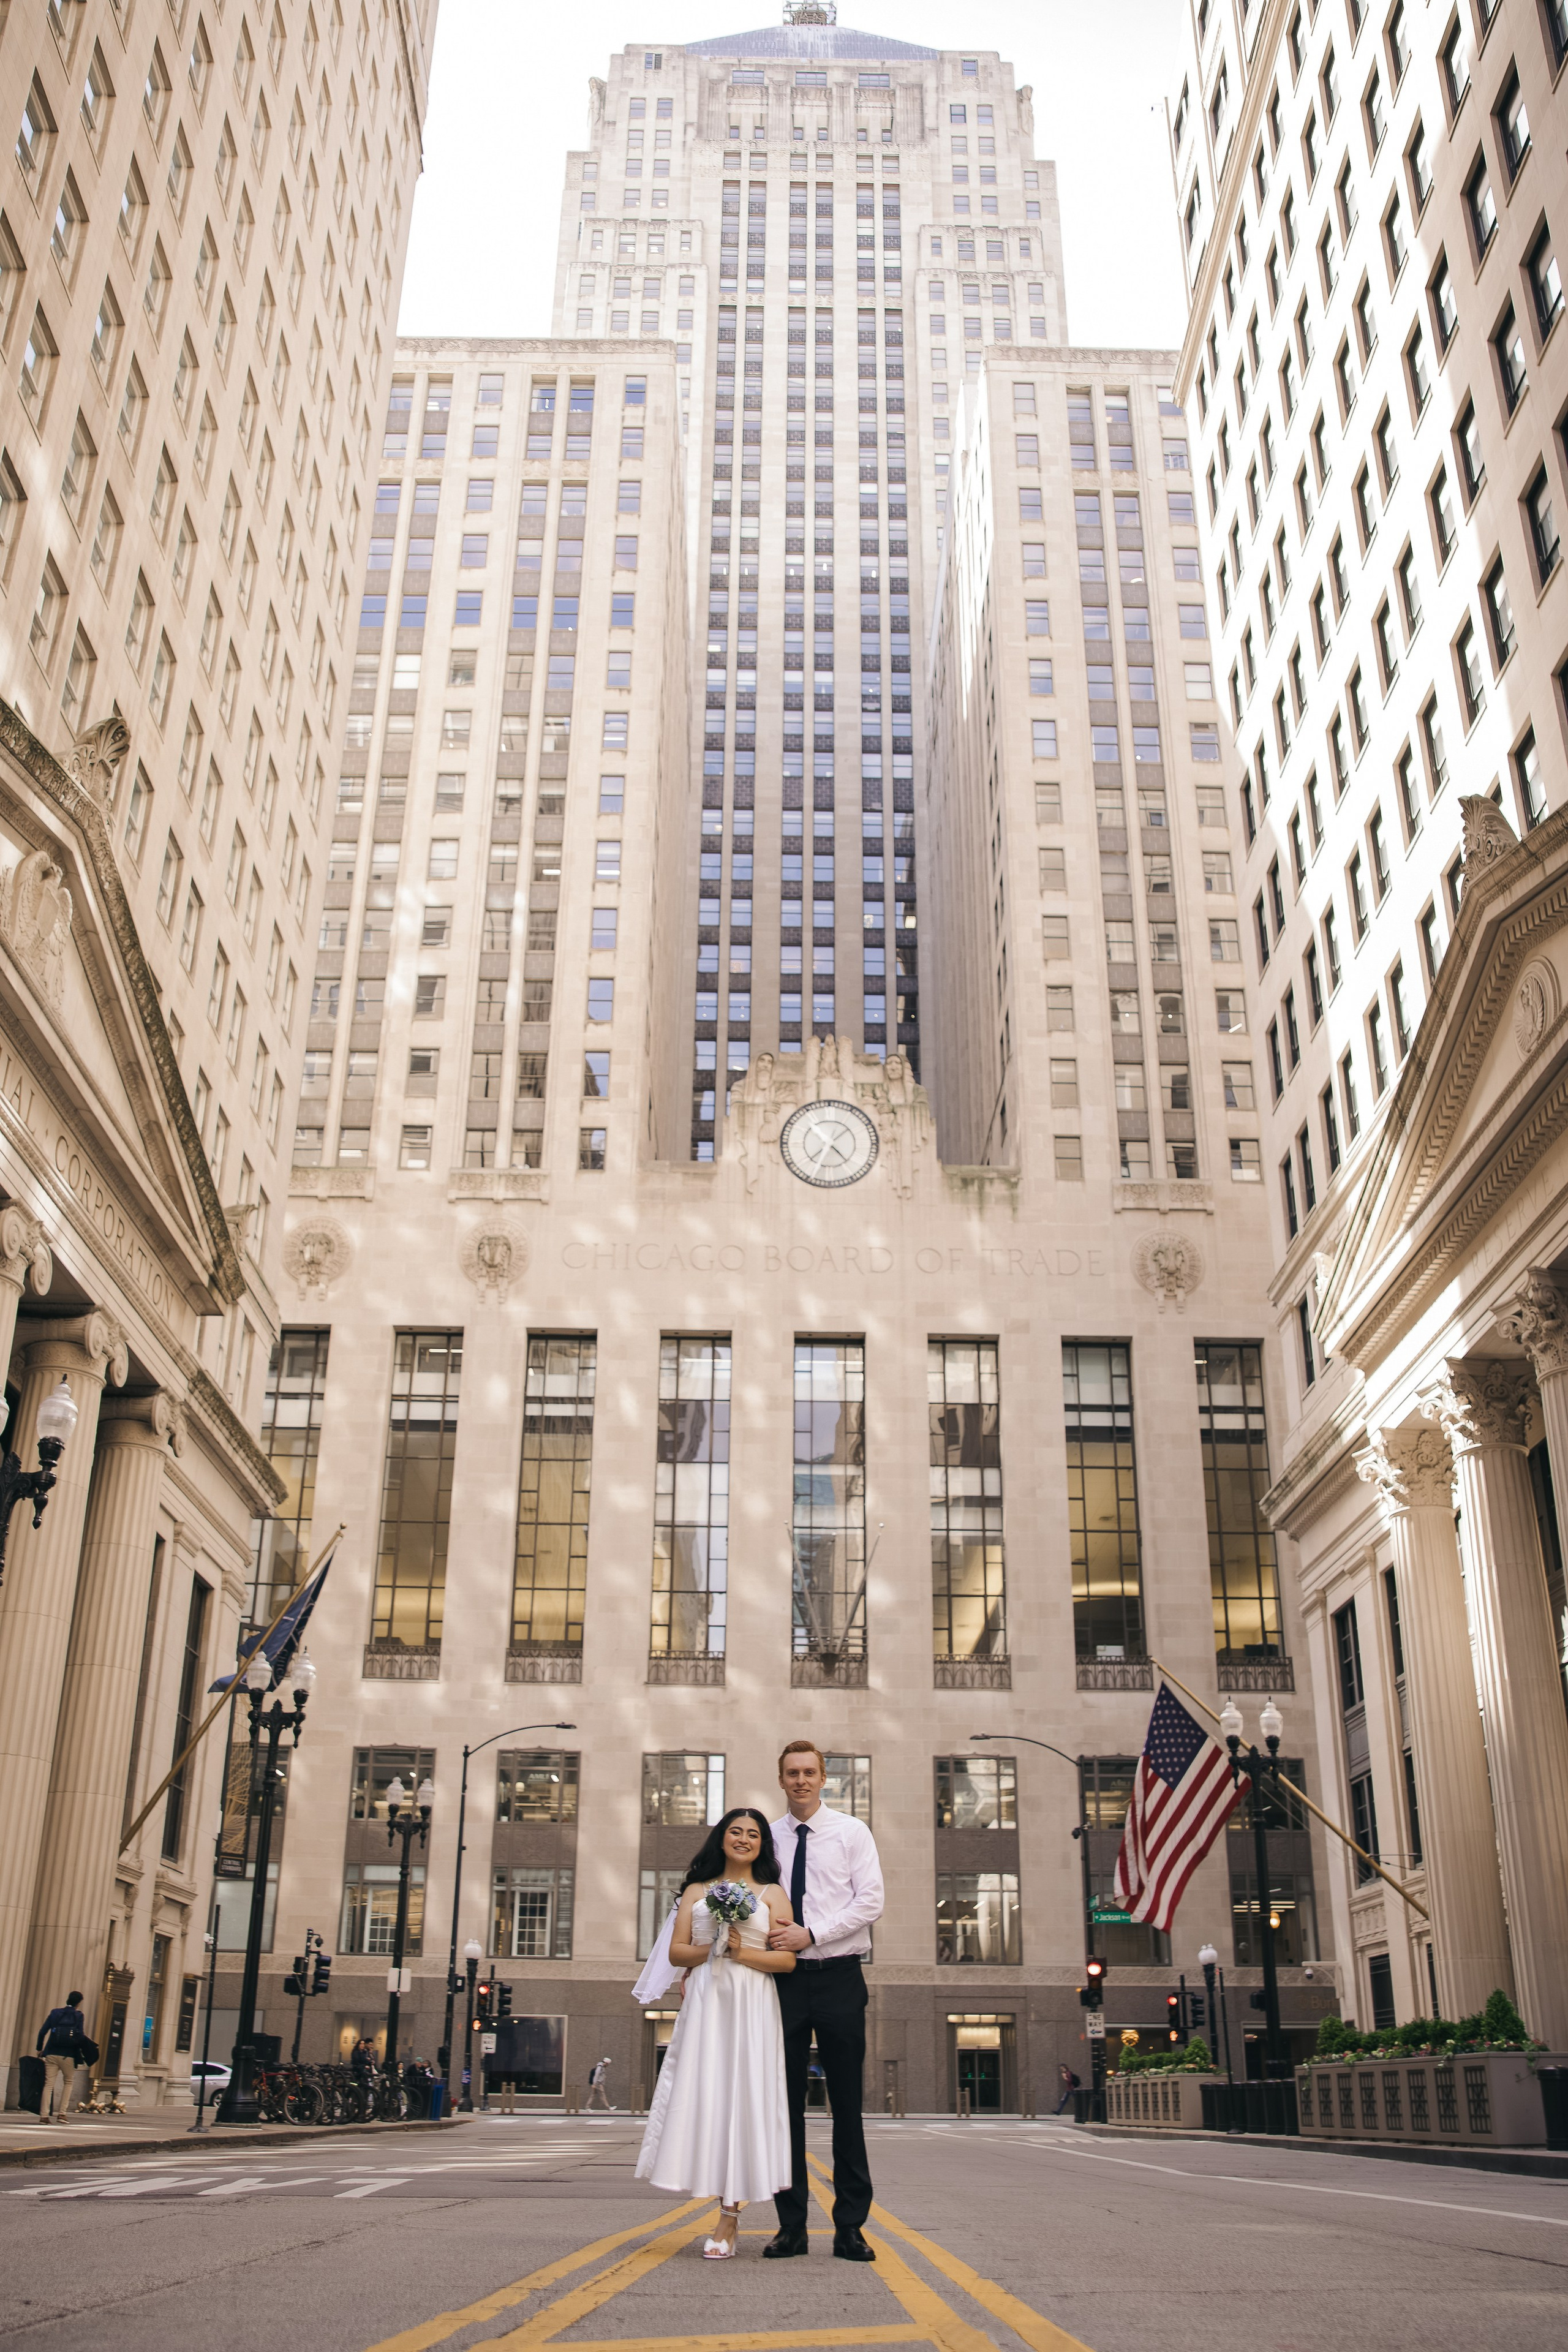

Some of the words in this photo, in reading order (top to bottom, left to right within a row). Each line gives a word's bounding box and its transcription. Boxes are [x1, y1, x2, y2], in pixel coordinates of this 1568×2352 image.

[55, 1134, 175, 1319] CORPORATION
[560, 1242, 746, 1272] CHICAGO
[763, 1245, 894, 1274] BOARD
[914, 1246, 964, 1275] OF
[982, 1248, 1107, 1277] TRADE
[1471, 1165, 1554, 1282] RESERVE
